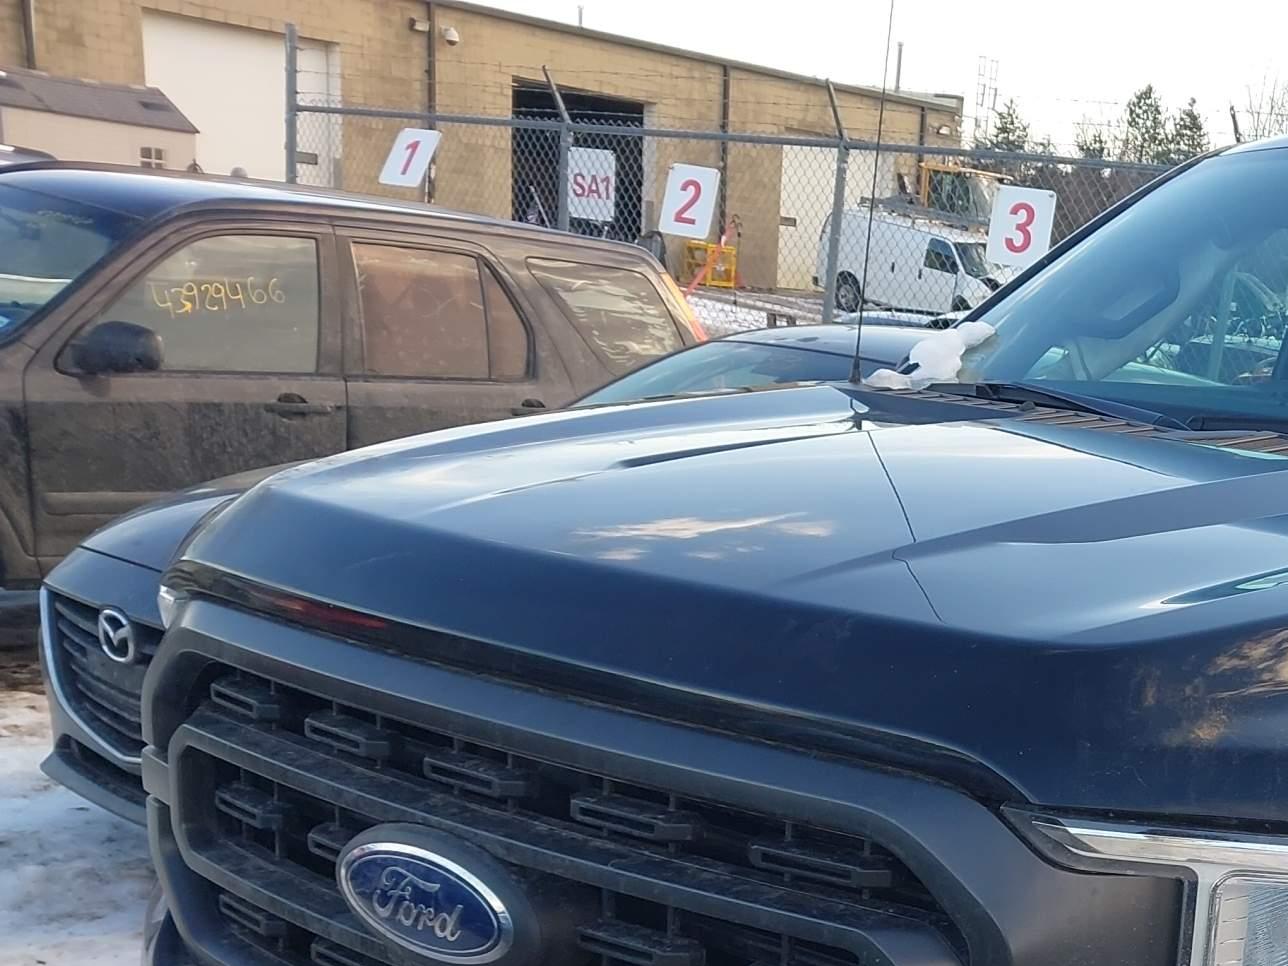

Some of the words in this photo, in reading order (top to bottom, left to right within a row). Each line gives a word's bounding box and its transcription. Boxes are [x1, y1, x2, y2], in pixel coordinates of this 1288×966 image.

[400, 139, 422, 176] 1
[573, 172, 611, 201] SA1
[674, 179, 702, 225] 2
[1005, 202, 1035, 253] 3
[151, 276, 286, 319] 43929466
[372, 866, 464, 942] Ford
